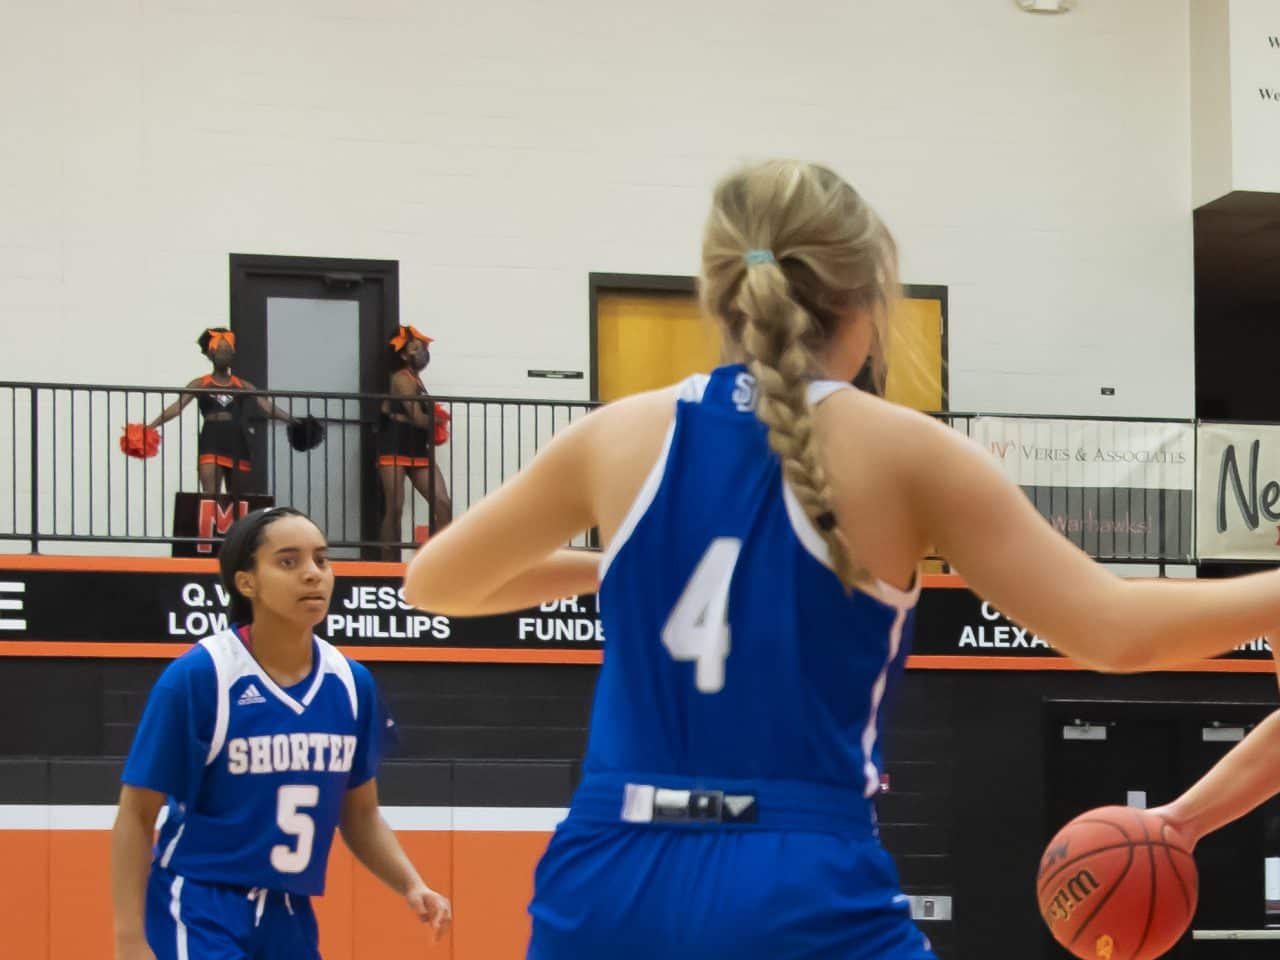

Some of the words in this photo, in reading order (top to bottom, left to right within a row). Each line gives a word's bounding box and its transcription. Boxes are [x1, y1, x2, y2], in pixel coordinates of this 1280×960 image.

[1259, 88, 1280, 102] We
[1021, 445, 1071, 463] VERES
[1075, 447, 1089, 463] &
[1093, 447, 1187, 465] ASSOCIATES
[326, 615, 451, 639] PHILLIPS
[661, 537, 744, 694] 4
[228, 732, 358, 775] SHORTER
[269, 784, 320, 874] 5
